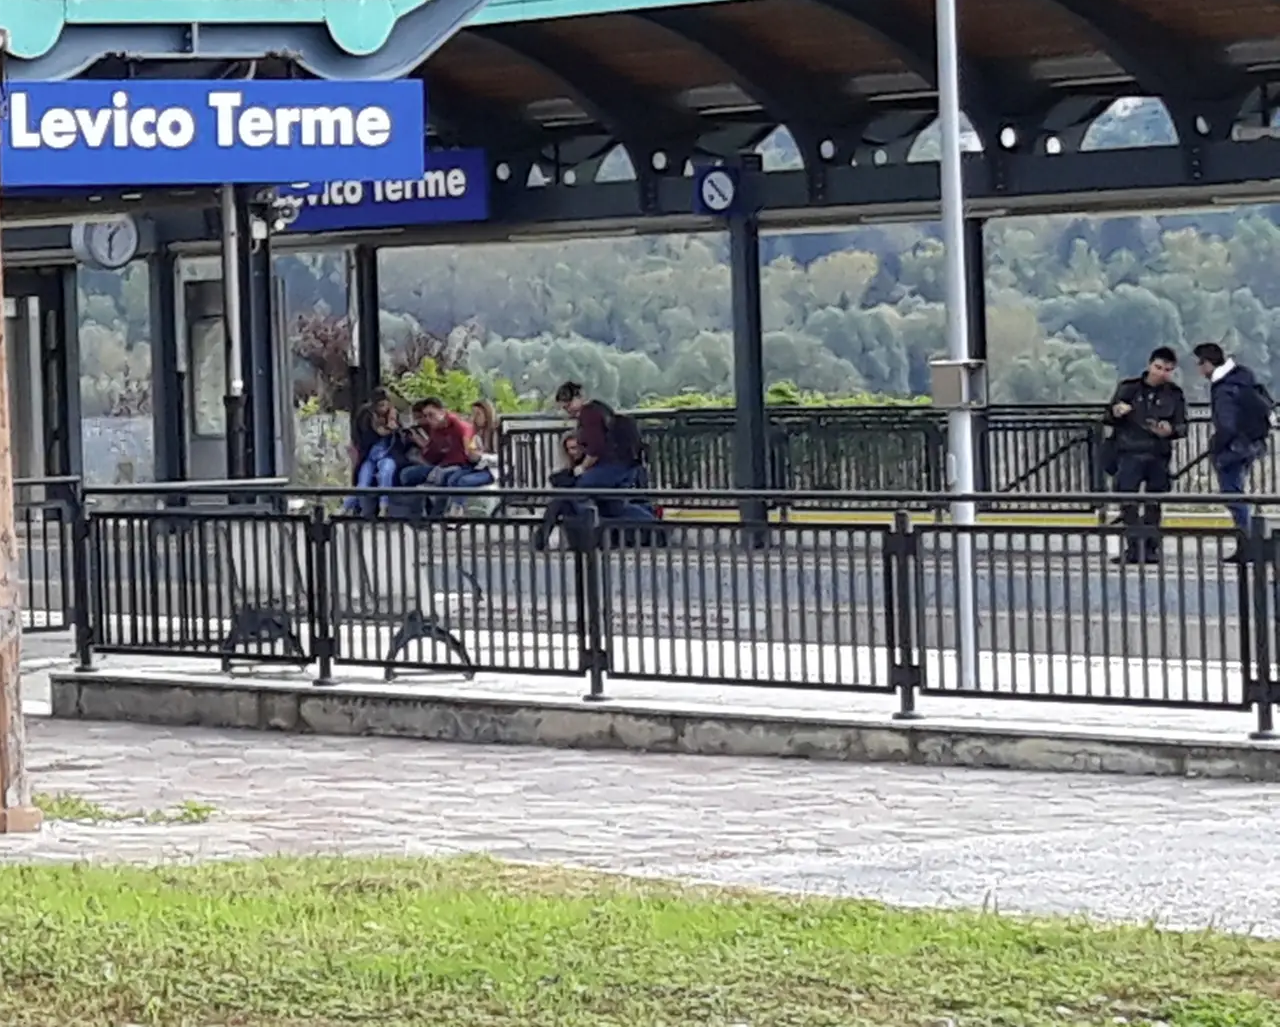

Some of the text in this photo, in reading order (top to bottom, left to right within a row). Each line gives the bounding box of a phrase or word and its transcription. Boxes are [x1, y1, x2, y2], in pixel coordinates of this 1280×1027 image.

[9, 90, 391, 149] Levico Terme
[272, 179, 363, 208] ico
